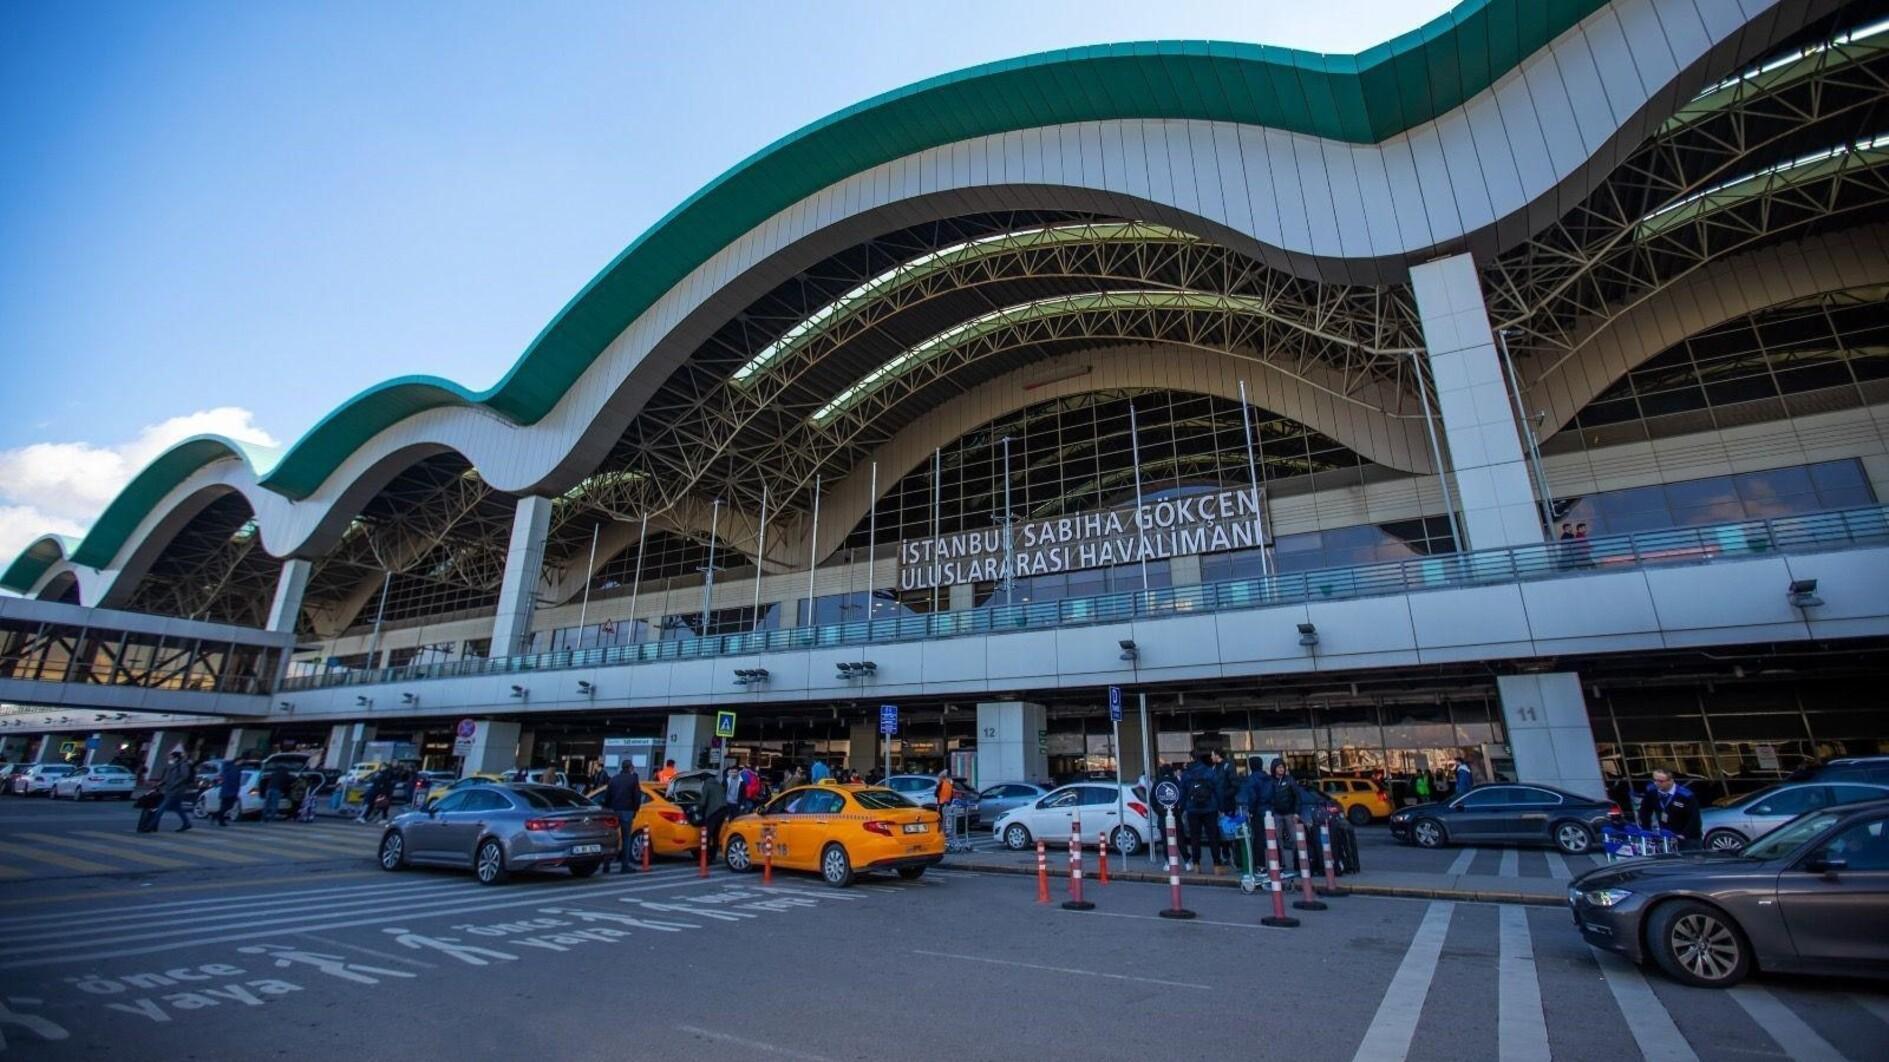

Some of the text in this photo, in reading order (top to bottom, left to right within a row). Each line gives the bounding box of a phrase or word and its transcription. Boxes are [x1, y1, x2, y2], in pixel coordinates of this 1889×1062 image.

[1024, 511, 1124, 547] SABİHA
[1135, 487, 1258, 530] GÖKÇEN
[1080, 519, 1261, 569] HAVALİMANI
[1517, 706, 1537, 721] 11
[983, 727, 996, 738] 12
[64, 963, 248, 994] önce
[104, 979, 304, 1022] yaya
